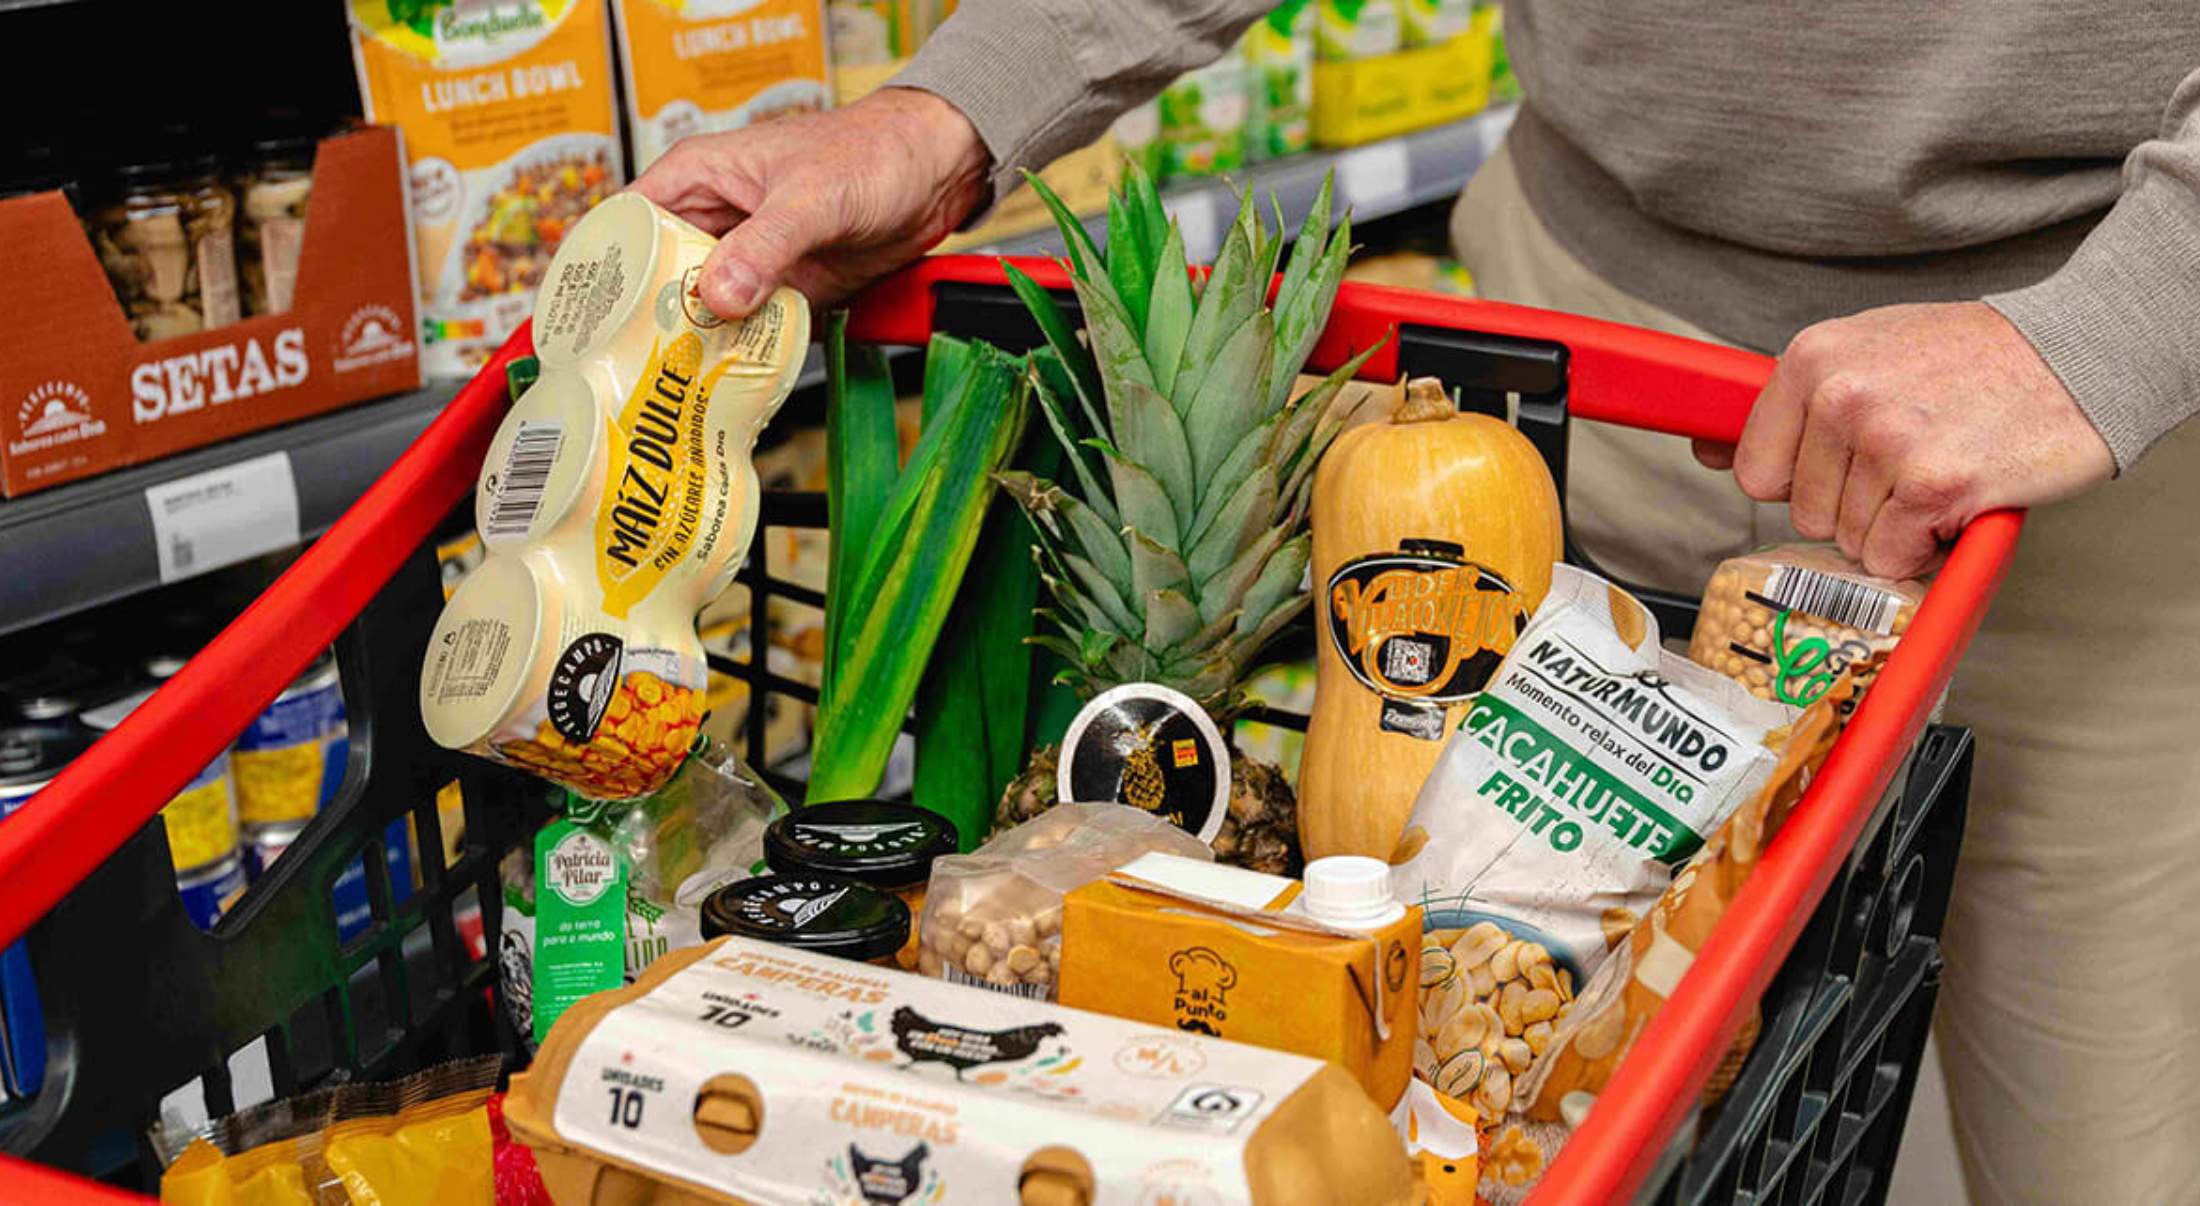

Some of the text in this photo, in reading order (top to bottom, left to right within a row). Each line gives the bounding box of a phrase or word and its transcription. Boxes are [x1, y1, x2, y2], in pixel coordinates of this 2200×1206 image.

[421, 60, 584, 113] LUNCH BOWL
[131, 327, 309, 424] SETAS
[607, 361, 693, 568] MAÍZ DULCE
[697, 499, 727, 561] Saborea
[1506, 672, 1581, 727] Momento
[1580, 716, 1628, 760] relax
[1625, 750, 1653, 777] del
[1529, 640, 1728, 772] NATURMUNDO
[1462, 706, 1675, 858] CACAHUETE
[1477, 771, 1583, 853] FRITO
[699, 1004, 751, 1028] 10
[1174, 998, 1227, 1022] Punto
[1191, 988, 1208, 1001] al
[602, 1067, 665, 1093] UNIDADES
[608, 1087, 644, 1130] 10
[831, 1096, 958, 1145] CAMPERAS
